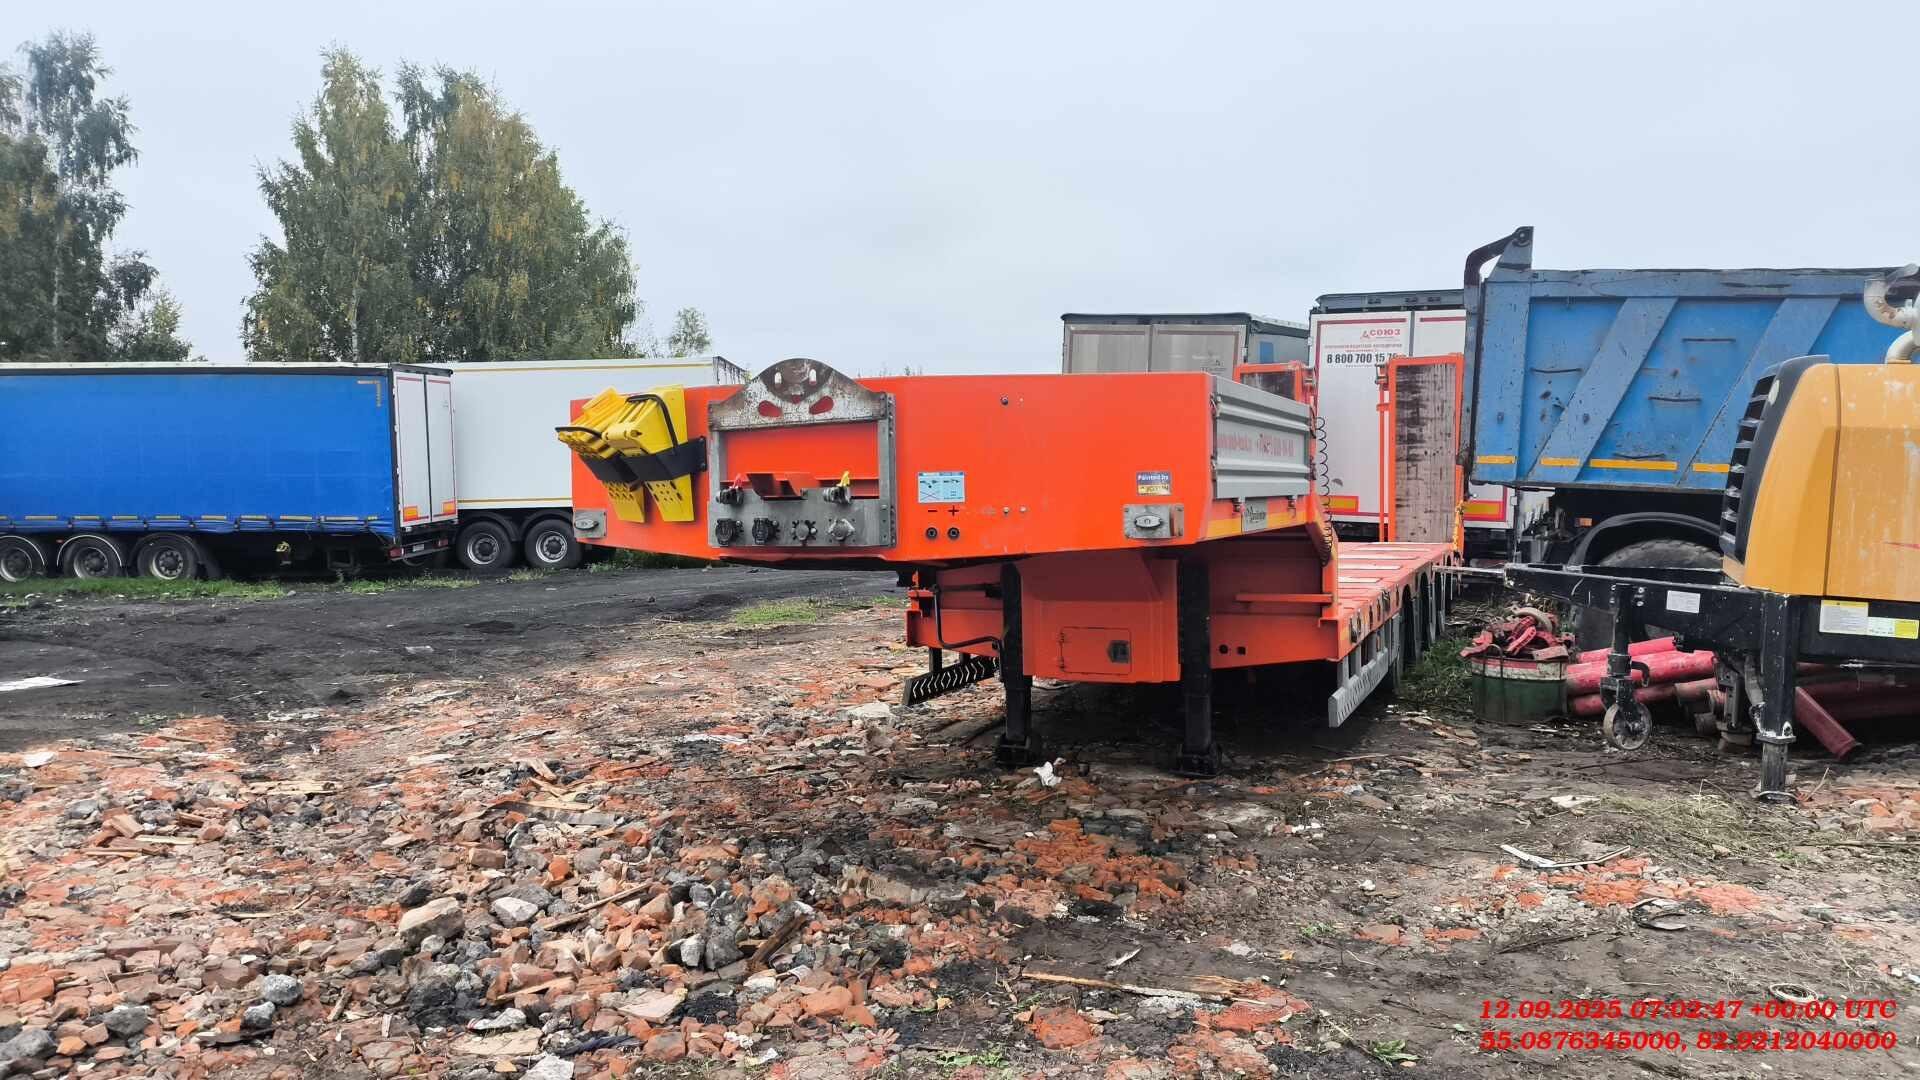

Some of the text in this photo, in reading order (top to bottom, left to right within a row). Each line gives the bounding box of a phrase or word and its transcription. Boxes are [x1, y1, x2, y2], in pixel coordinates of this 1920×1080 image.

[1369, 328, 1401, 336] СОЮЗ
[1327, 353, 1333, 364] 8
[1334, 353, 1353, 363] 800
[1354, 353, 1372, 363] 700
[1374, 352, 1385, 362] 15
